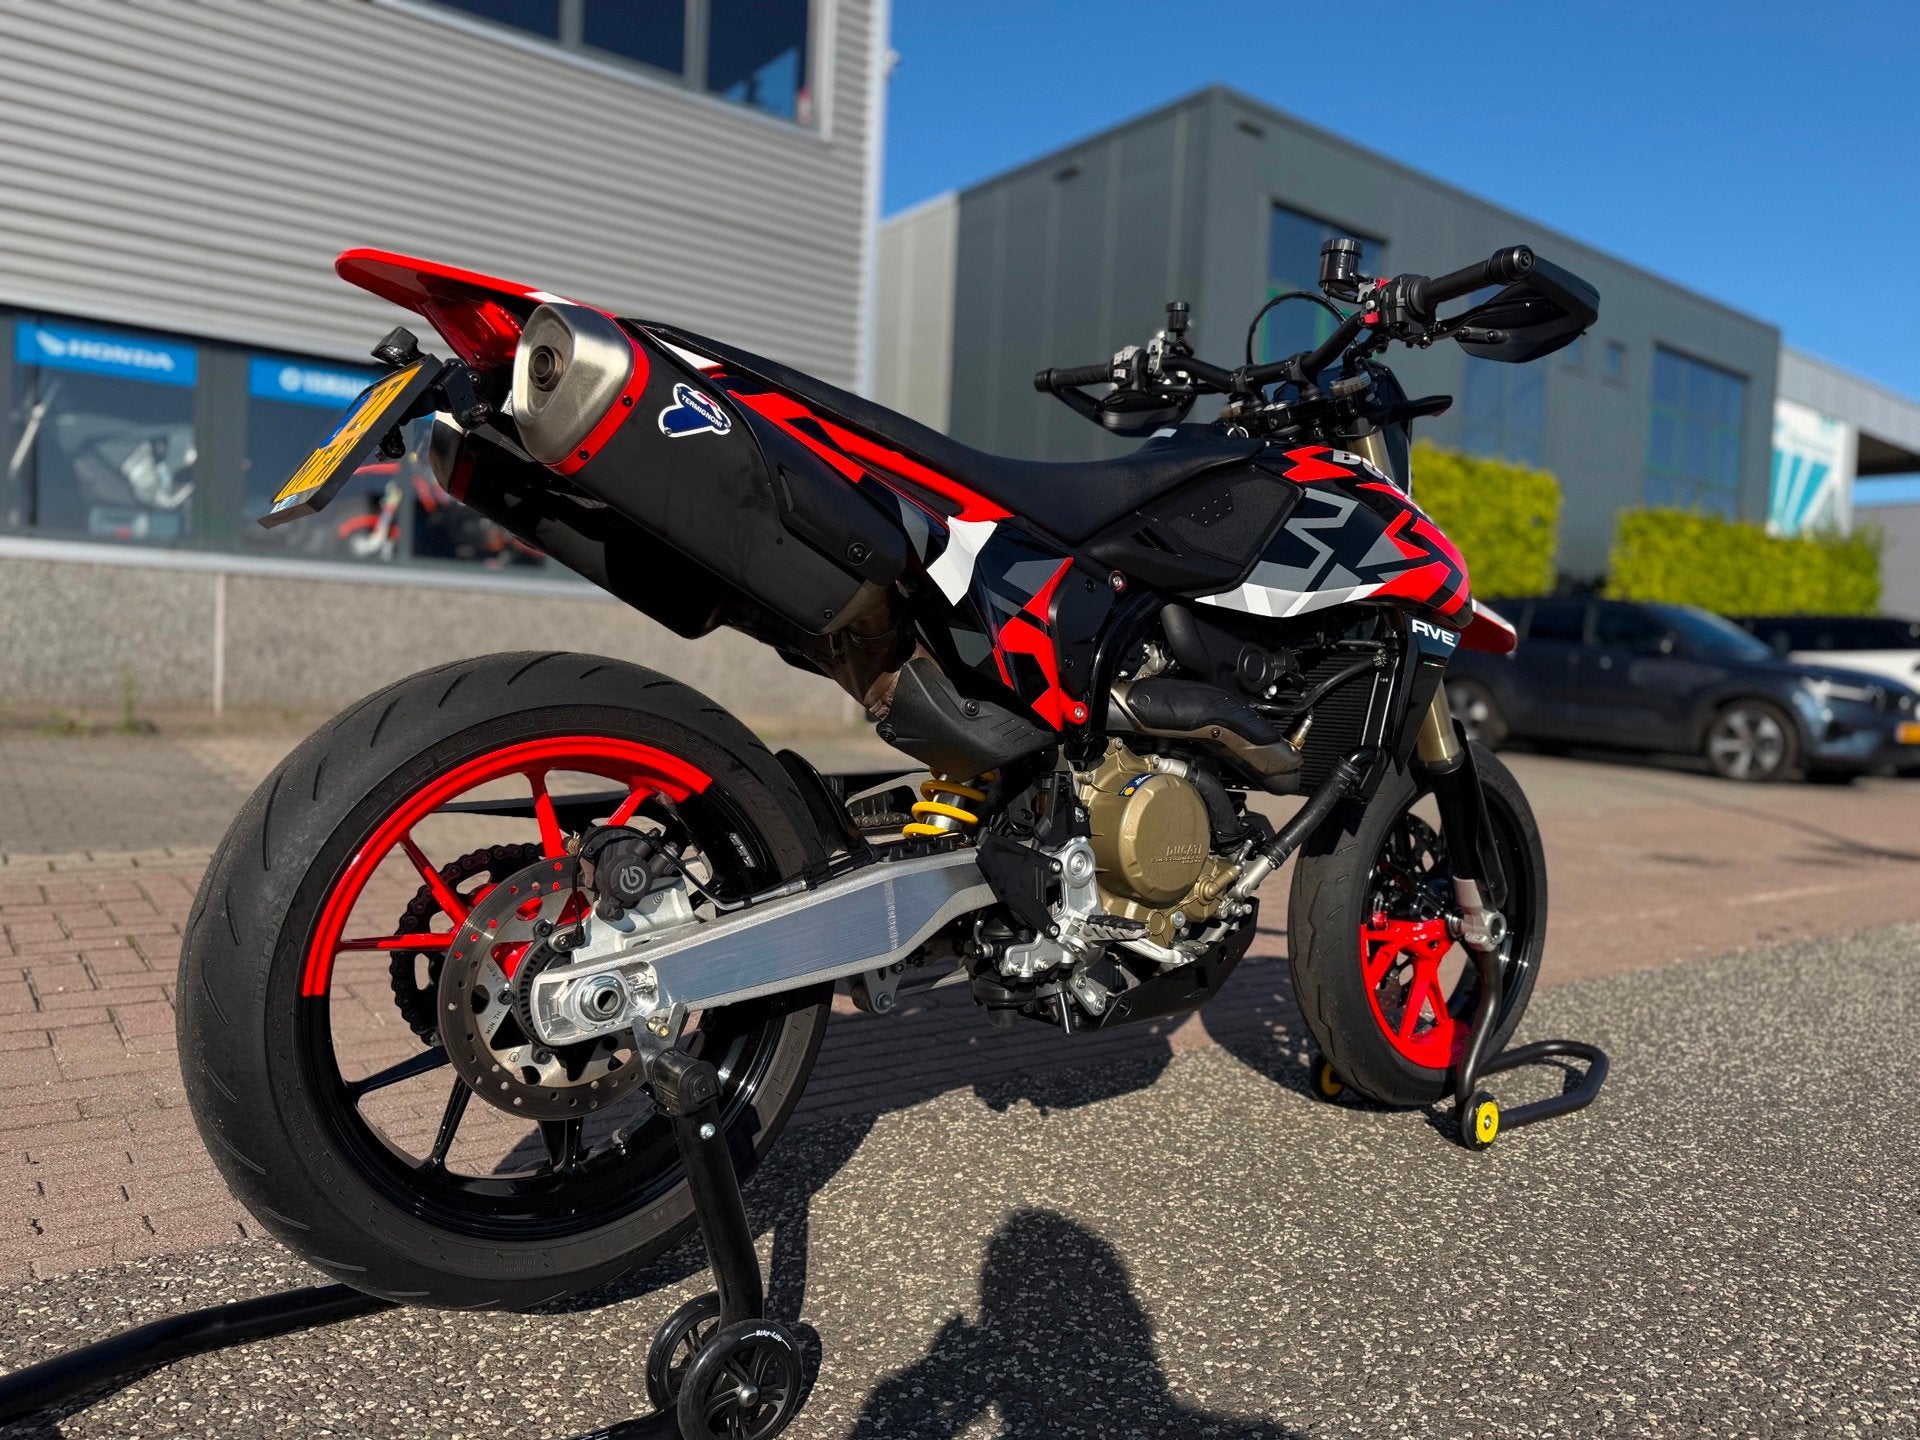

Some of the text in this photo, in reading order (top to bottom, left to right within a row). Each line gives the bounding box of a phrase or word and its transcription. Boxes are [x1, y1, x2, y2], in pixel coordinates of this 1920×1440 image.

[66, 338, 175, 372] HONDA
[681, 394, 723, 428] TERMIGNONI
[1166, 843, 1202, 857] DUCATI
